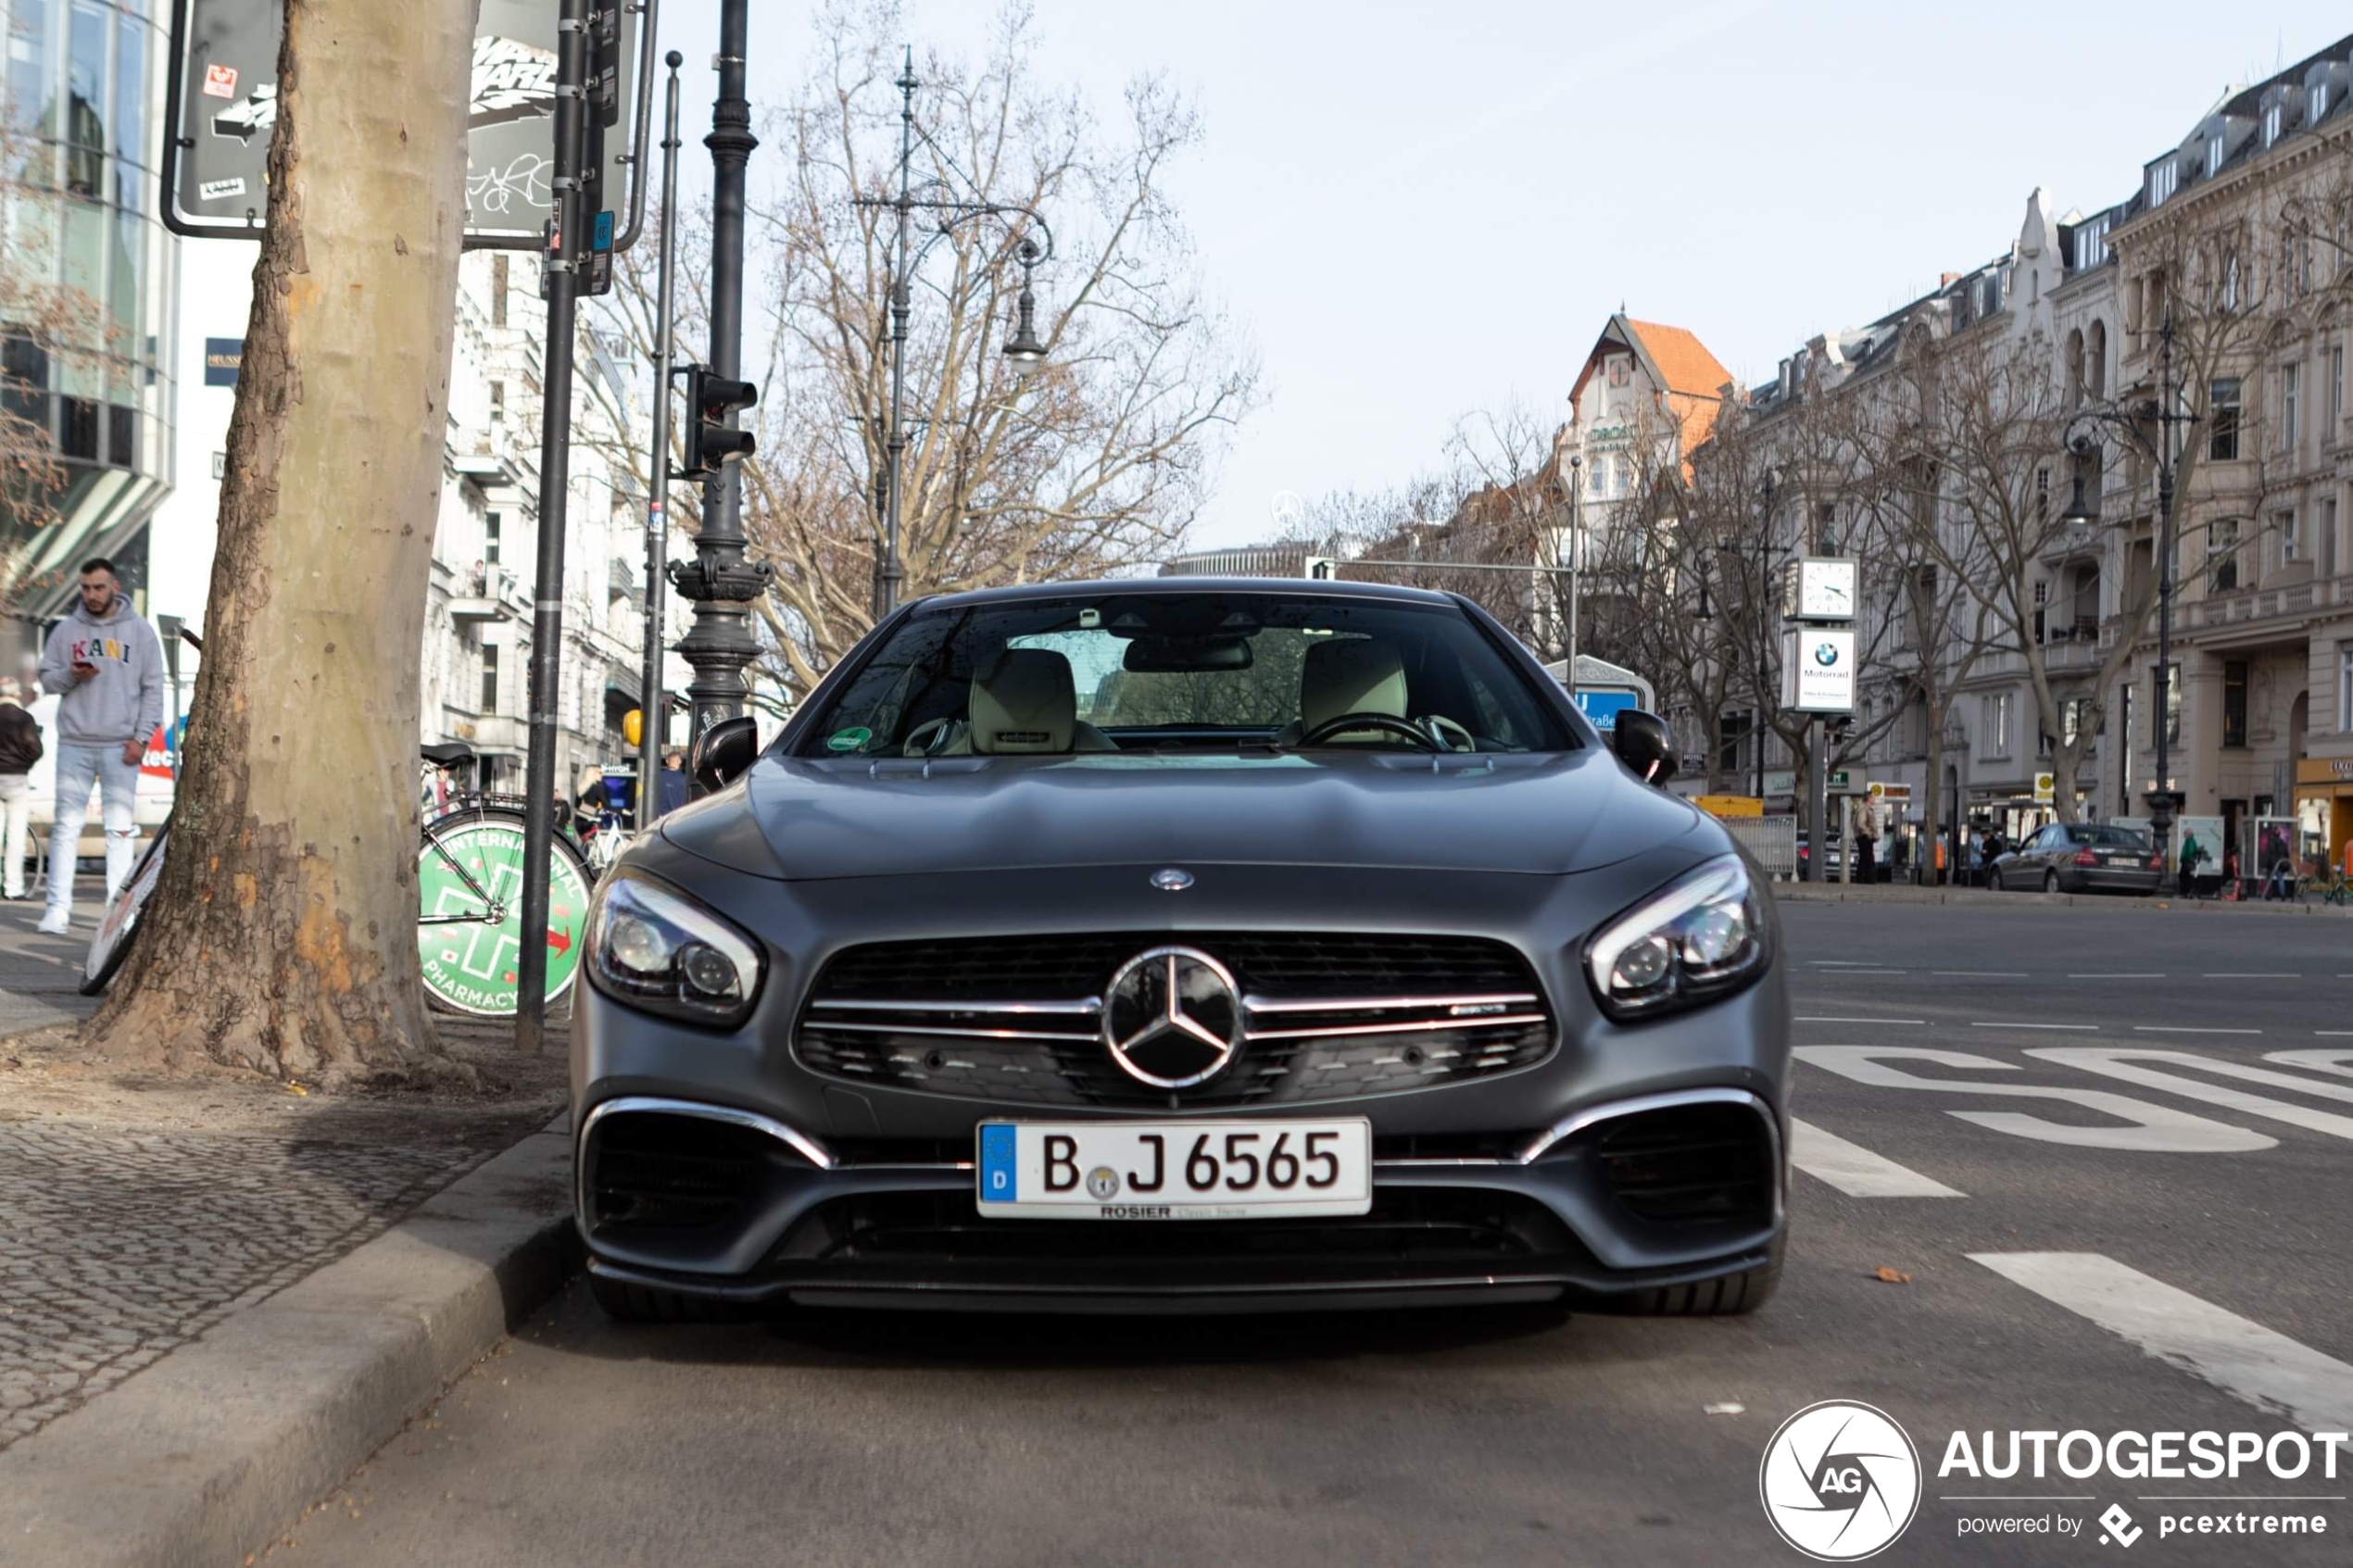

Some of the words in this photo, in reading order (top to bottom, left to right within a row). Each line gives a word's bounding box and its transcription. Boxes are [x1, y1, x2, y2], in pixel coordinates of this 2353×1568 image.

[72, 638, 131, 664] KANI
[1805, 669, 1849, 680] Motorrad
[424, 959, 519, 1007] PHARMACY
[1043, 1134, 1081, 1193] B
[1127, 1135, 1165, 1193] J
[1185, 1131, 1340, 1193] 6565
[993, 1170, 1007, 1190] D
[1101, 1206, 1172, 1220] ROSIER
